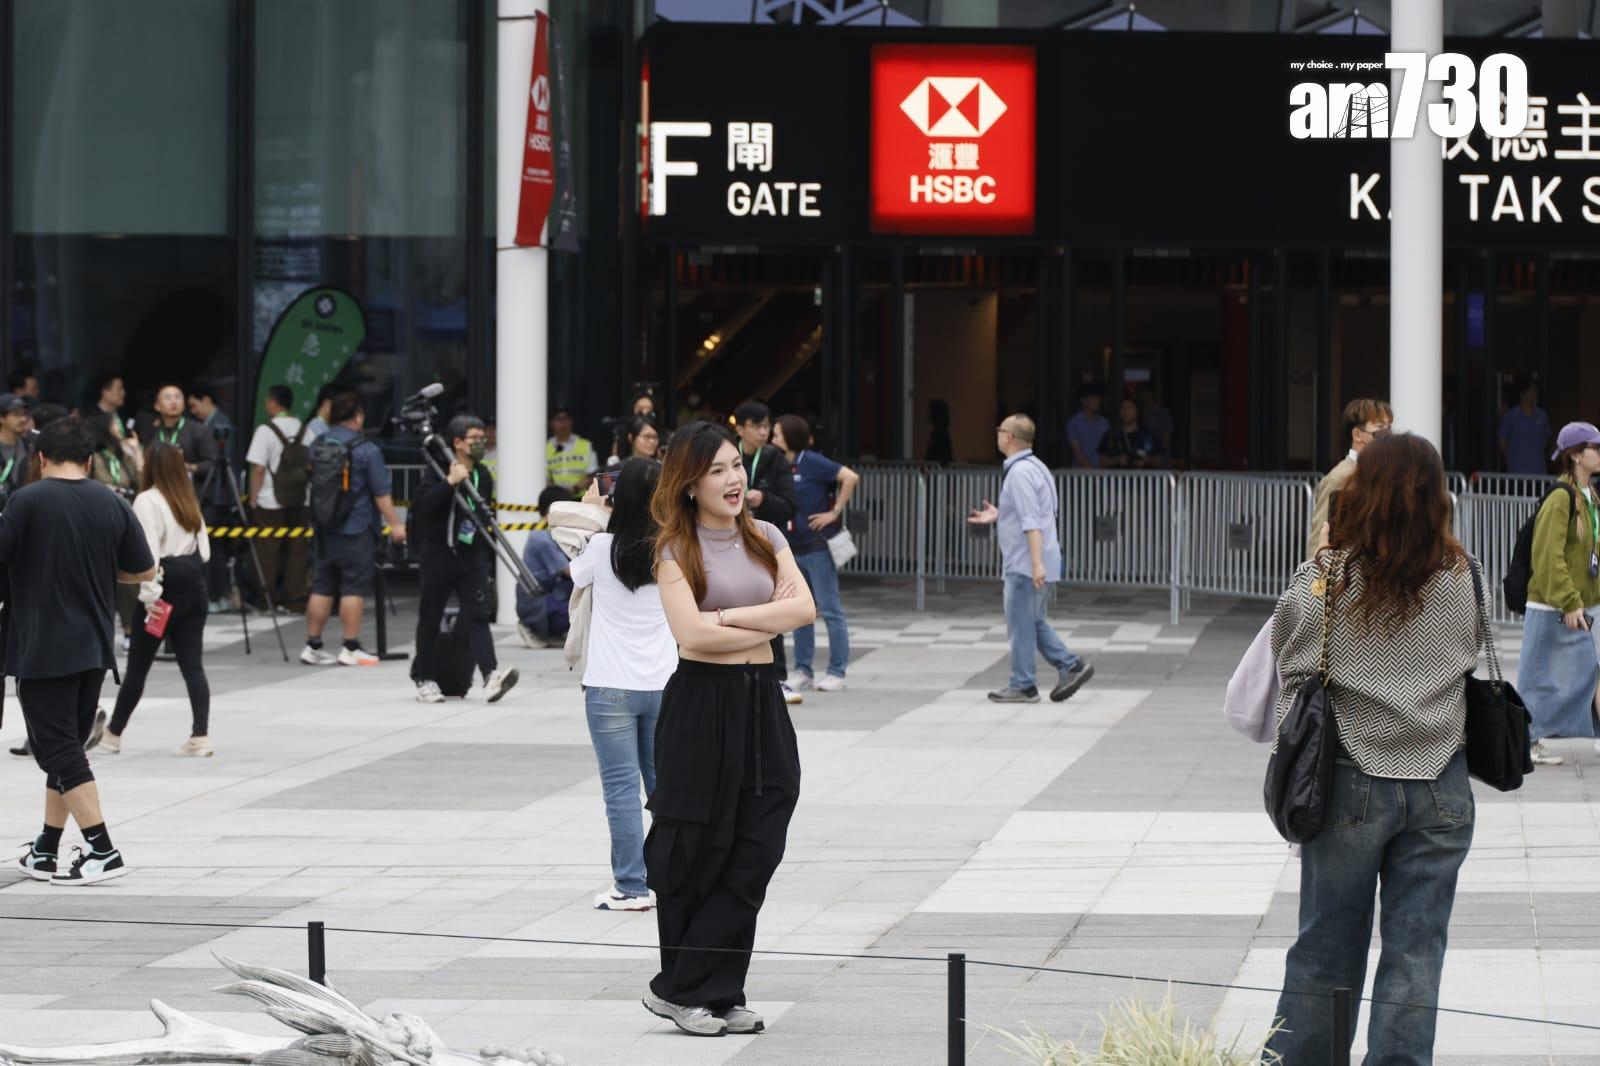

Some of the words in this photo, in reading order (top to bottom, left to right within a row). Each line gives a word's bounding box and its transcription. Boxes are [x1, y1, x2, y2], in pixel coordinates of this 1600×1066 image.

[651, 121, 711, 216] F
[727, 122, 773, 172] 閘
[727, 182, 822, 217] GATE
[909, 174, 997, 204] HSBC
[1458, 174, 1563, 223] TAK
